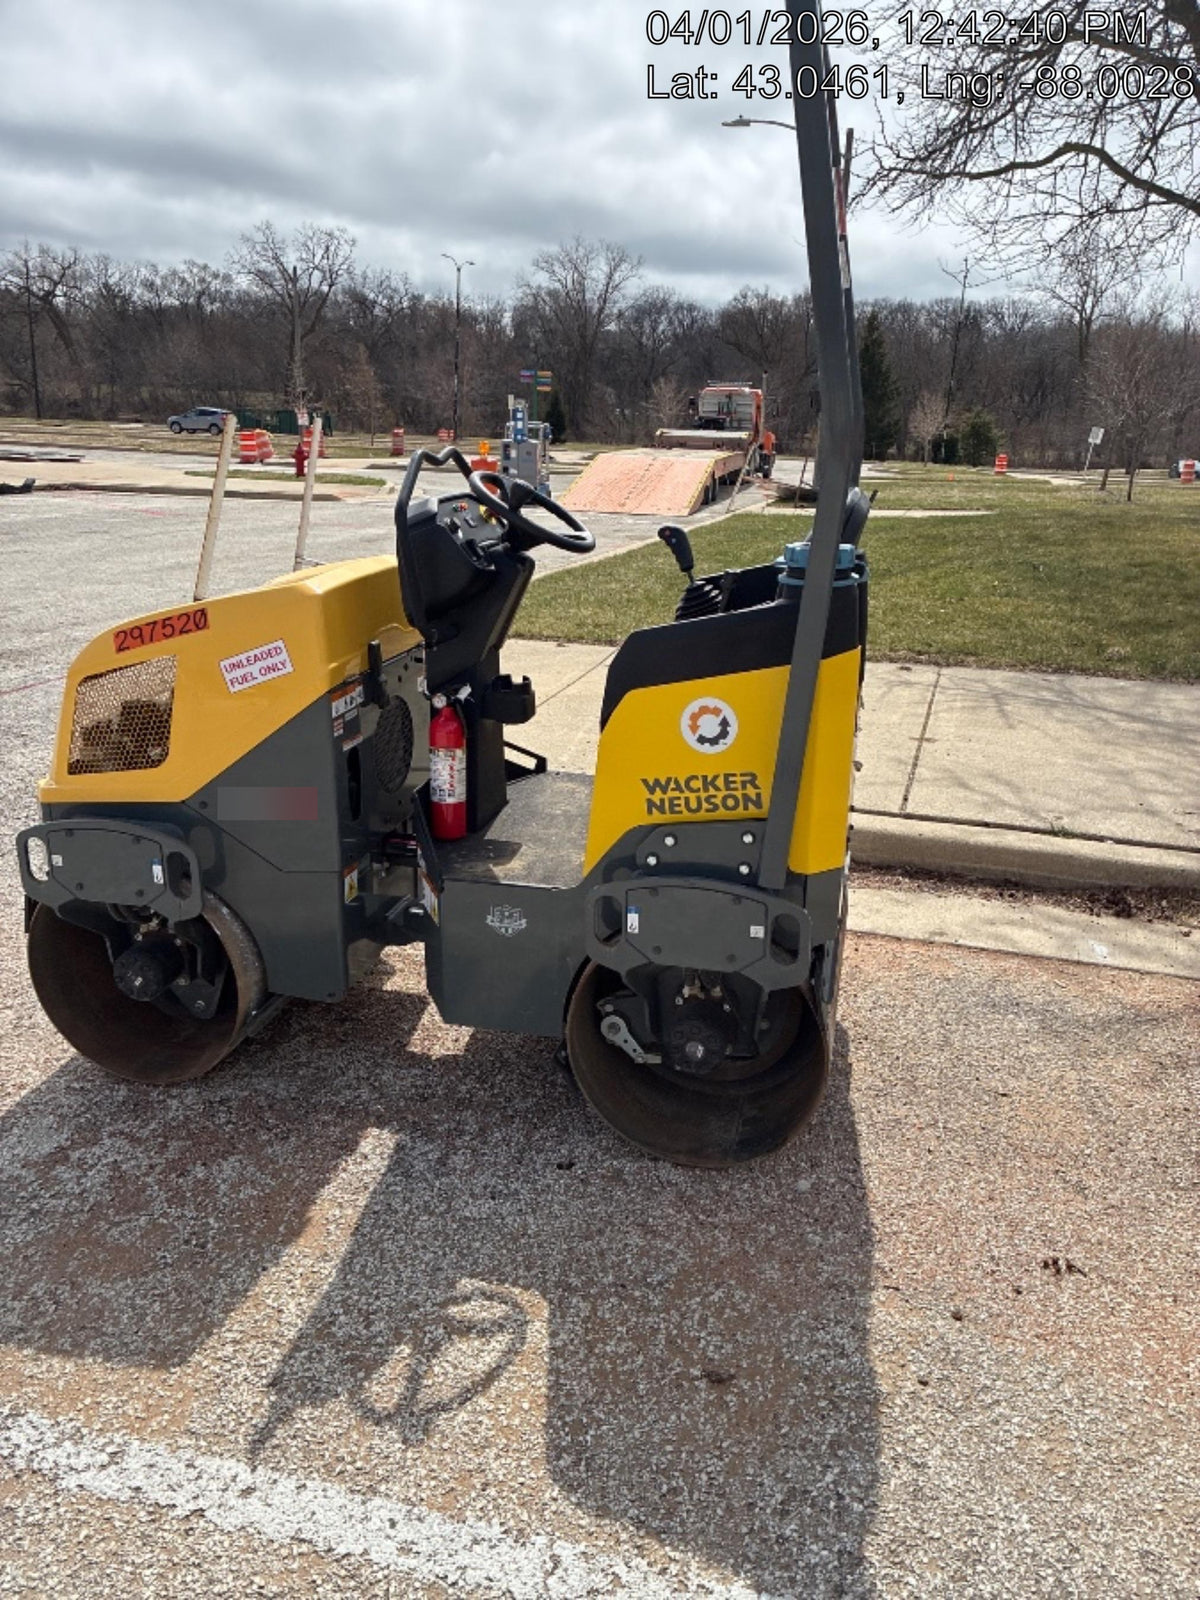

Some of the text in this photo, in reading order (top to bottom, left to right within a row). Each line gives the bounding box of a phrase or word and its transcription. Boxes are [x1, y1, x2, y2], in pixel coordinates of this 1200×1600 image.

[115, 608, 208, 652] 297520
[223, 645, 283, 674] UNLEADED
[229, 659, 288, 689] FUEL ONLY
[640, 772, 762, 796] WACKER
[646, 792, 763, 815] NEUSON
